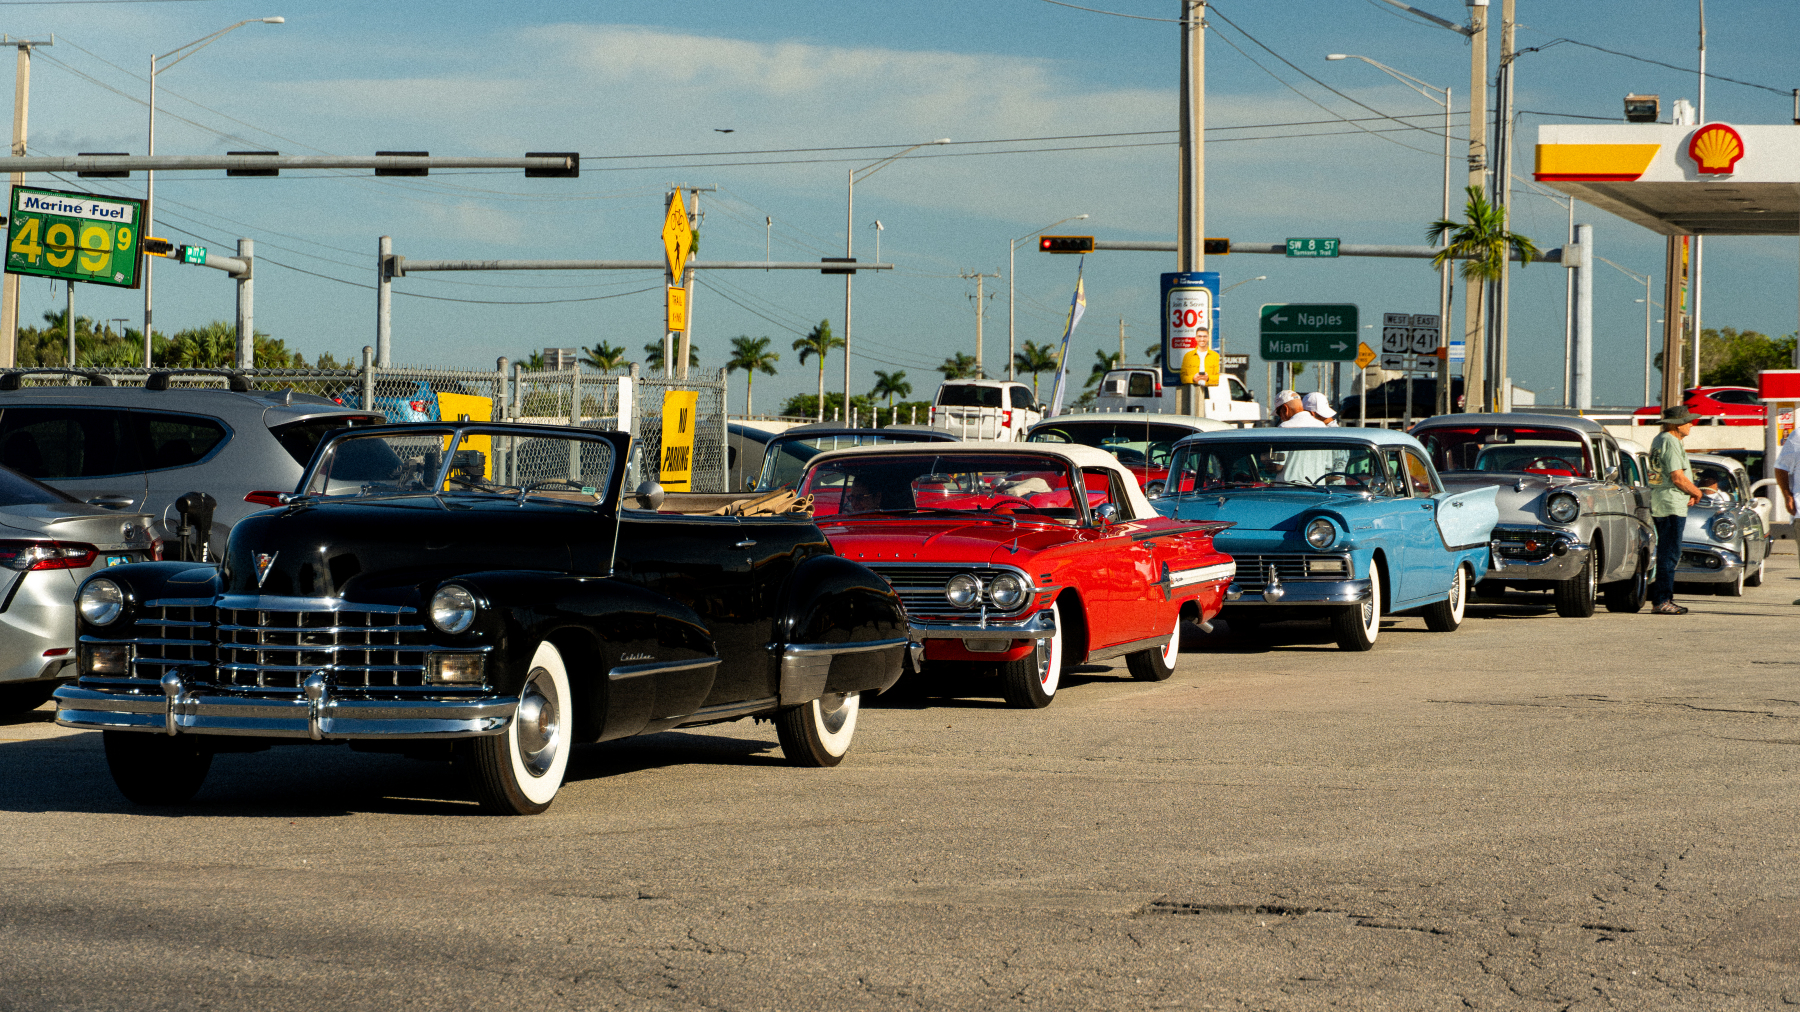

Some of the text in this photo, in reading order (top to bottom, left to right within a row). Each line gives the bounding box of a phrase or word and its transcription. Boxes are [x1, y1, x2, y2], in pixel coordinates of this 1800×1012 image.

[25, 197, 124, 219] Marine Fuel
[1289, 239, 1336, 251] SW 8 ST
[1297, 313, 1342, 328] Naples
[1387, 315, 1407, 325] WEST
[1416, 316, 1435, 326] EAST
[1269, 340, 1309, 353] Miami
[1386, 333, 1404, 348] 41
[1416, 334, 1434, 349] 41
[662, 445, 689, 472] PARKING
